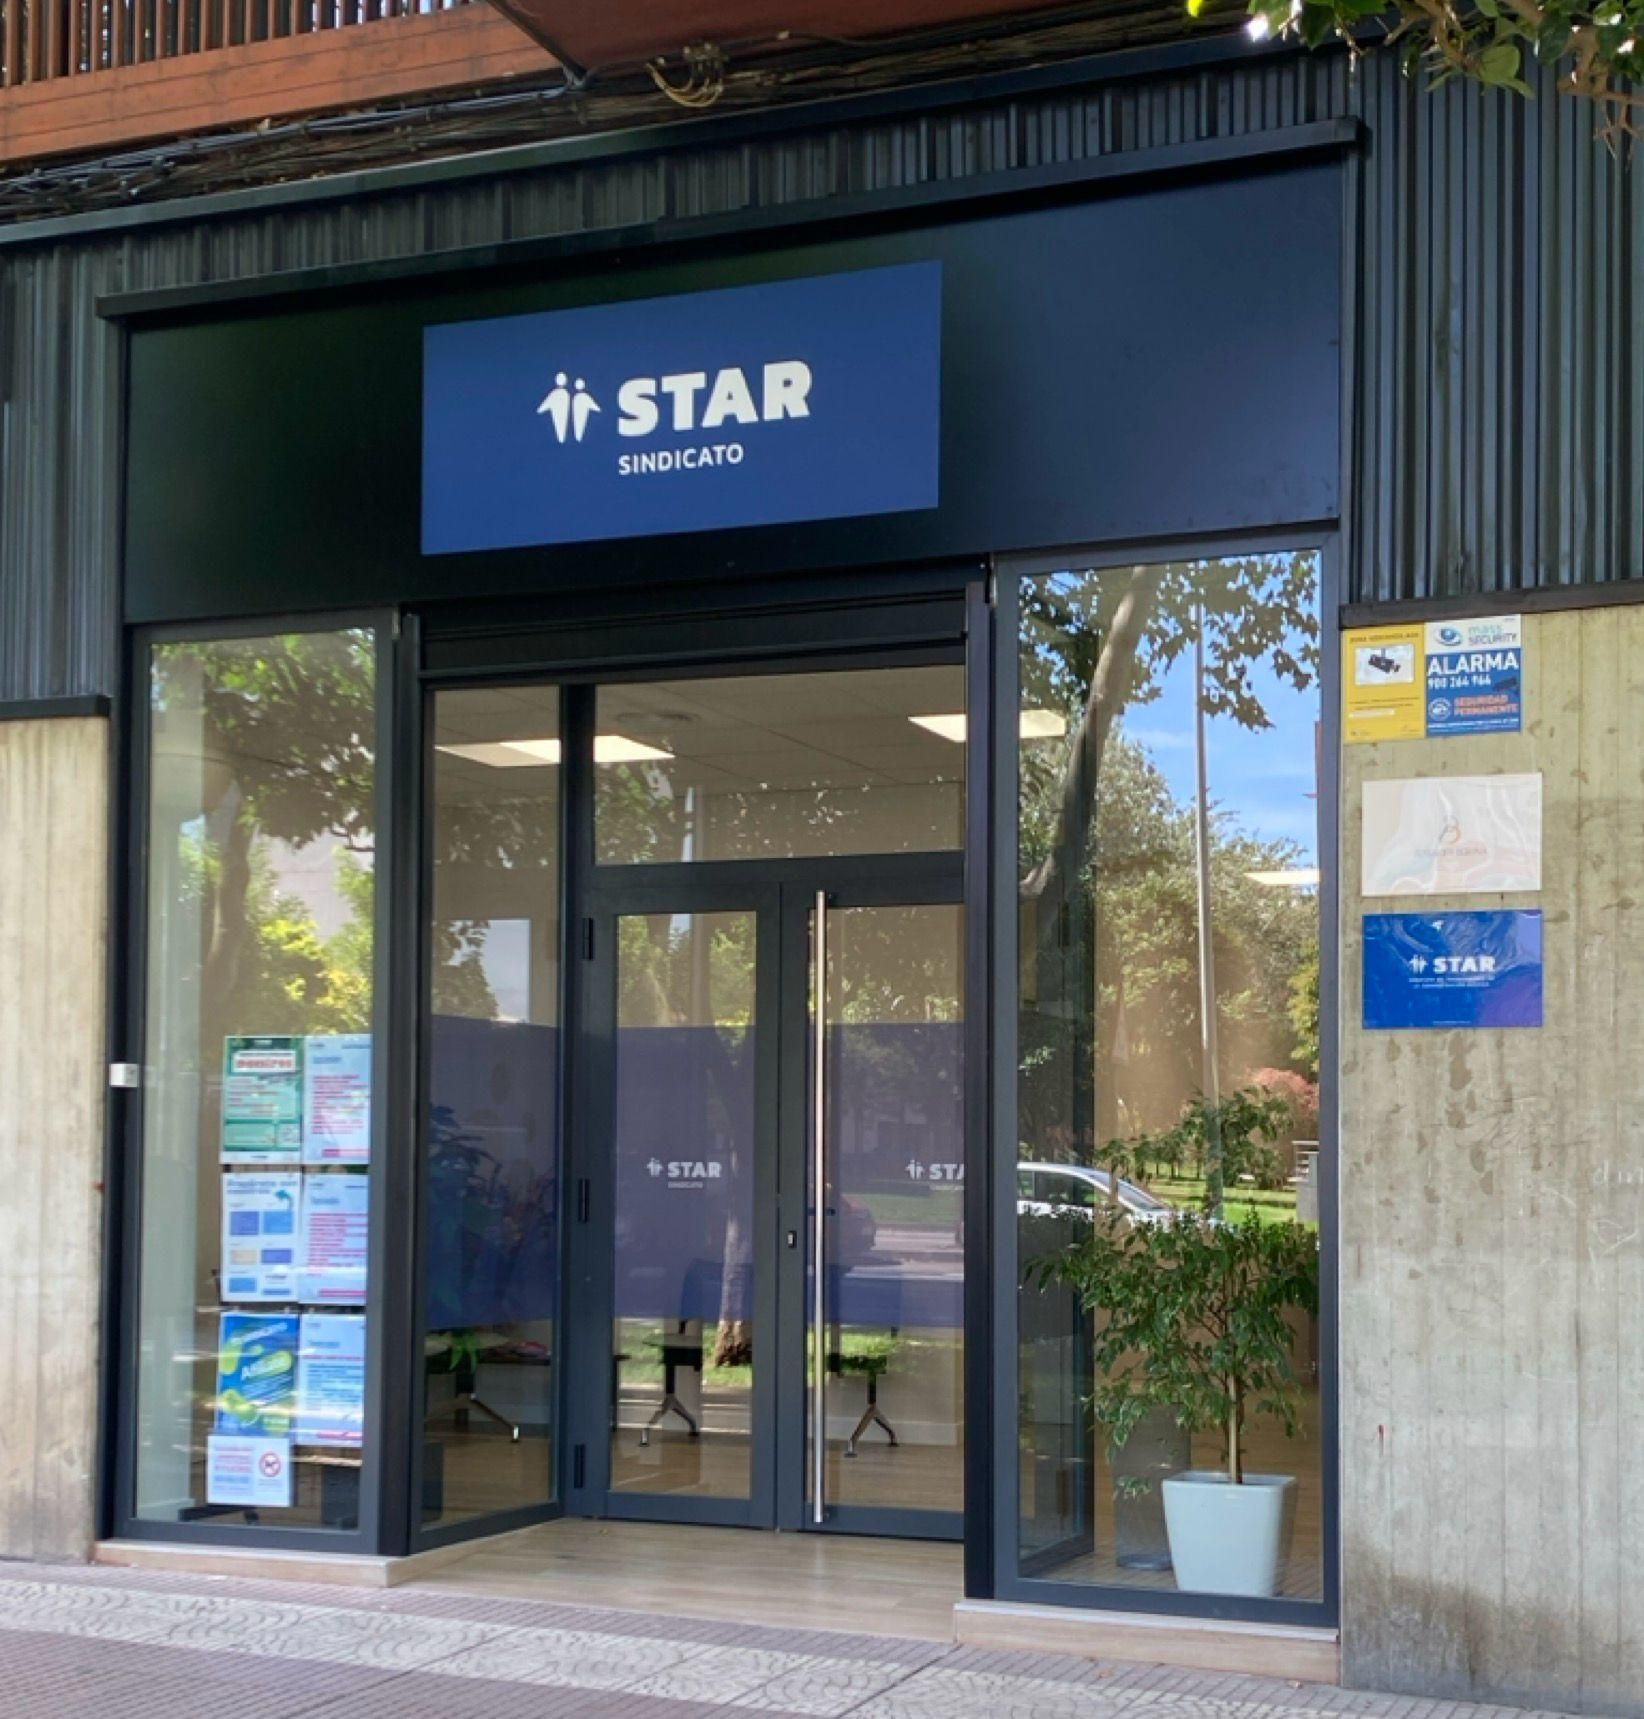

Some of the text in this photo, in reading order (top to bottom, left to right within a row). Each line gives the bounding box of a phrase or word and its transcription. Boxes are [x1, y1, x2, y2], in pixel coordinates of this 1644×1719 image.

[617, 360, 813, 436] STAR
[618, 443, 744, 476] SINDICATO
[1427, 650, 1519, 676] ALARMA
[1433, 955, 1496, 974] STAR
[667, 1161, 721, 1178] STAR
